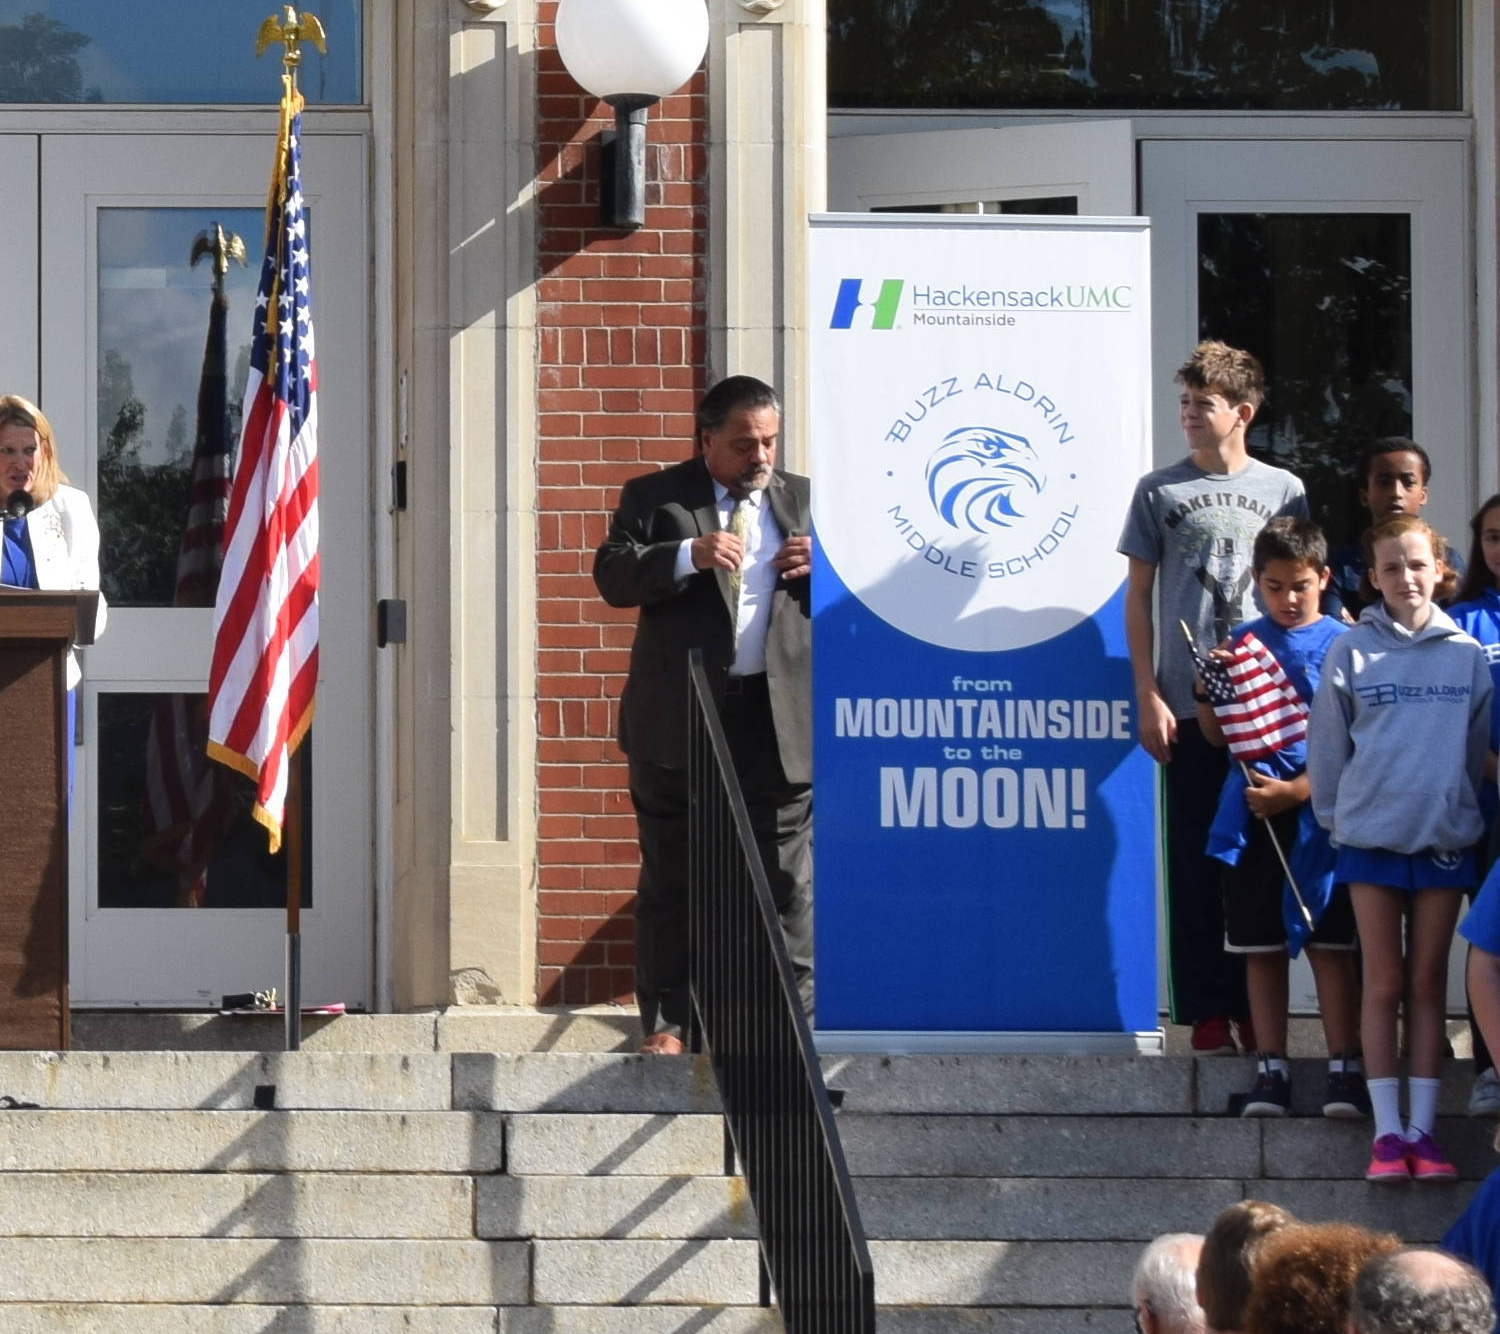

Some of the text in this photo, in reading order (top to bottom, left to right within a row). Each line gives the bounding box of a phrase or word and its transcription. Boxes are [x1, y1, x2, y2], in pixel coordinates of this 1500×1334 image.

[913, 313, 1016, 327] Mountainside
[884, 373, 1075, 444] BUZZ ALDRIN
[1164, 492, 1274, 529] MAKE IT RAIN
[887, 504, 1079, 578] MIDDLE SCHOOL
[952, 675, 1013, 692] from
[1426, 685, 1470, 698] ALDRIN
[834, 698, 1131, 740] MOUNTAINSIDE
[943, 745, 1022, 760] to the
[880, 767, 1086, 829] MOON!
